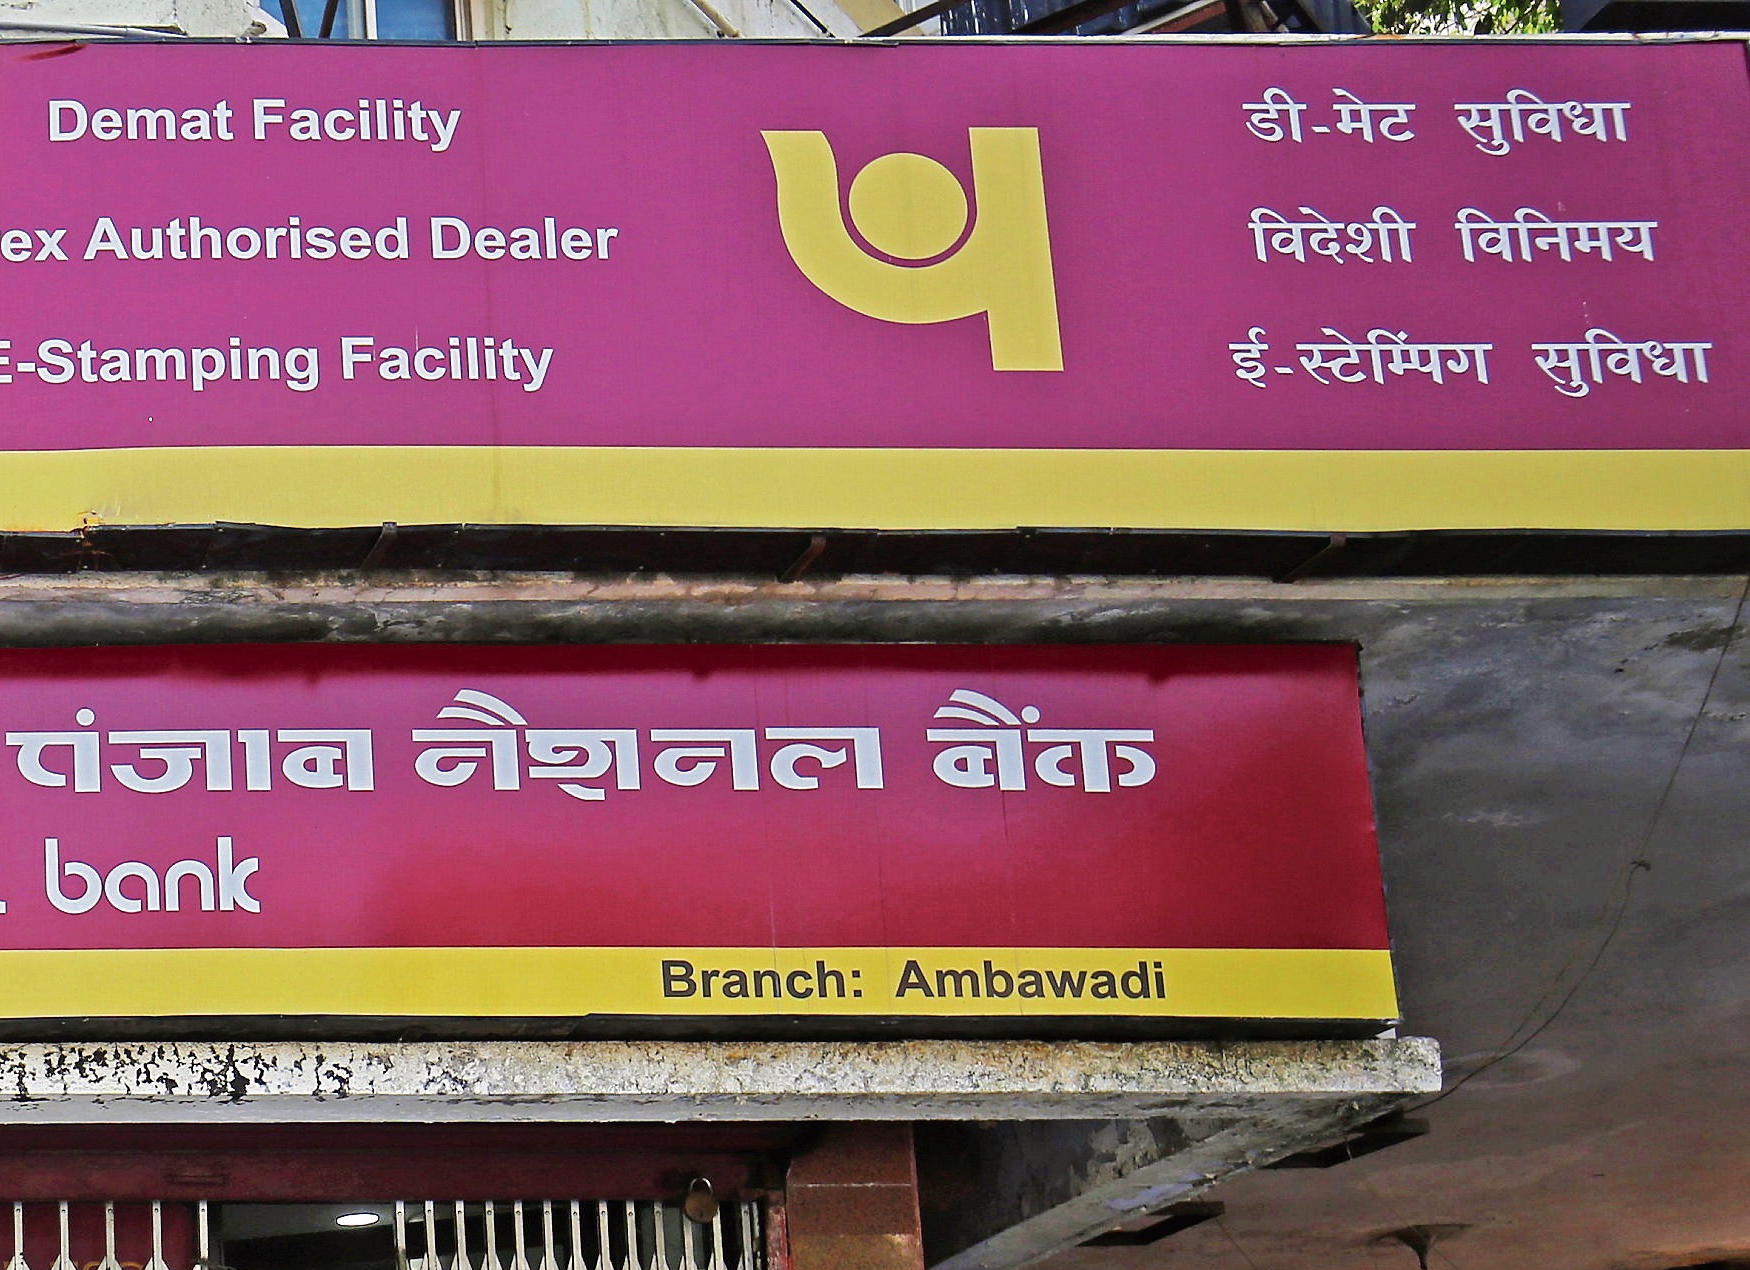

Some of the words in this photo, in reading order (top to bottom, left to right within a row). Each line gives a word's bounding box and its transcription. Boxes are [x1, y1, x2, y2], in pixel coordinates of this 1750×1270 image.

[48, 98, 235, 142] Demat
[252, 98, 462, 153] Facility
[1242, 87, 1415, 145] डी-मेट
[1454, 88, 1631, 156] सुविधा
[84, 216, 410, 262] Authorised
[430, 216, 620, 261] Dealer
[1247, 206, 1416, 264] विदेशी
[1454, 206, 1657, 263] विनिमय
[340, 336, 554, 392] Facility
[1531, 328, 1712, 398] सुविधा
[5, 708, 375, 794] पंजाब
[412, 688, 884, 801] नैशनल
[926, 688, 1156, 792] बैंक
[45, 836, 261, 913] bank
[661, 960, 862, 999] Branch:
[895, 960, 1166, 999] Ambawadi
